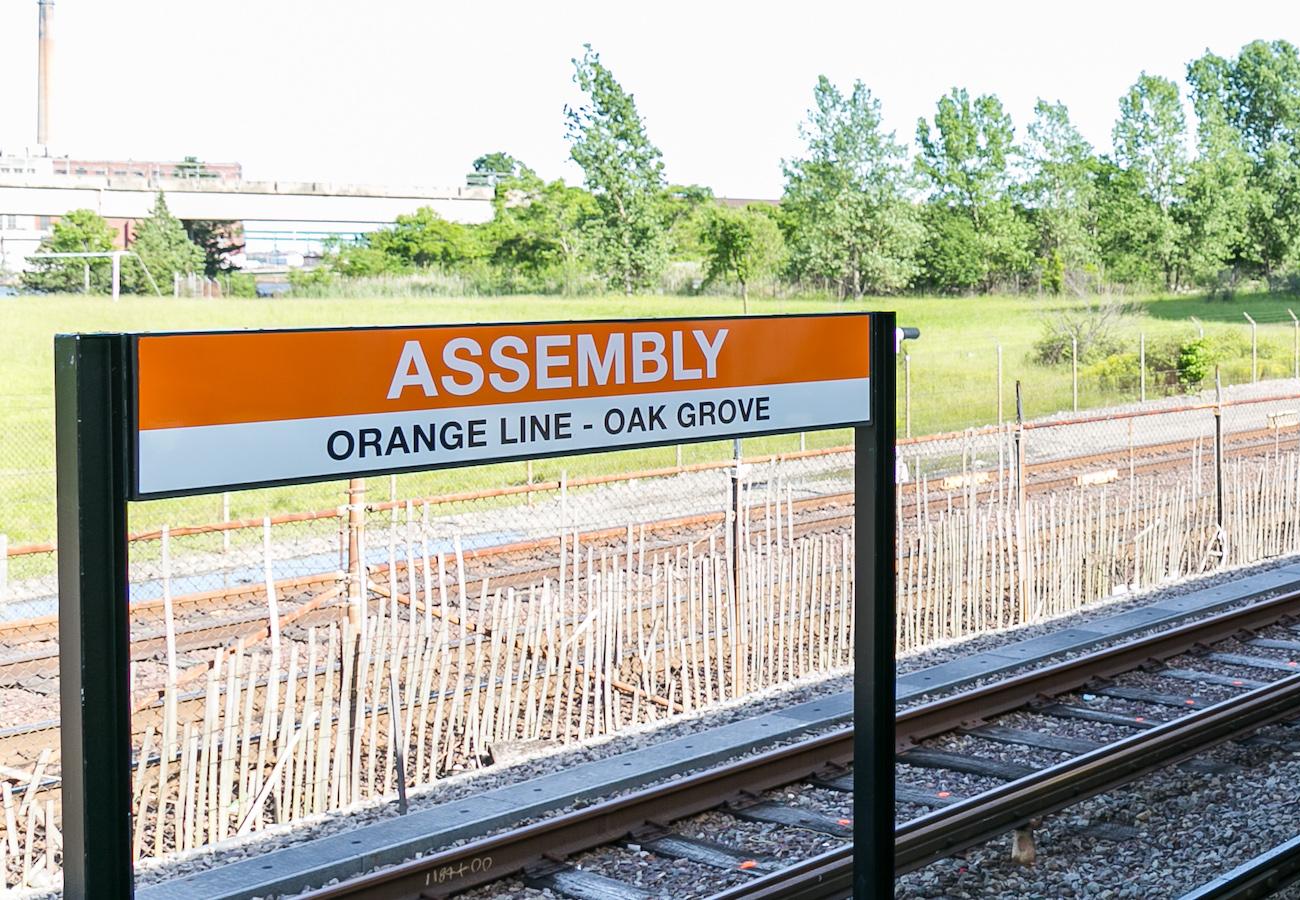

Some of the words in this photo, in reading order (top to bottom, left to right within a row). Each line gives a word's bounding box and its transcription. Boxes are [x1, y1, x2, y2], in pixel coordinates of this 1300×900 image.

[386, 328, 729, 400] ASSEMBLY
[326, 418, 487, 461] ORANGE
[500, 412, 572, 445] LINE
[603, 404, 668, 435] OAK
[677, 396, 770, 428] GROVE
